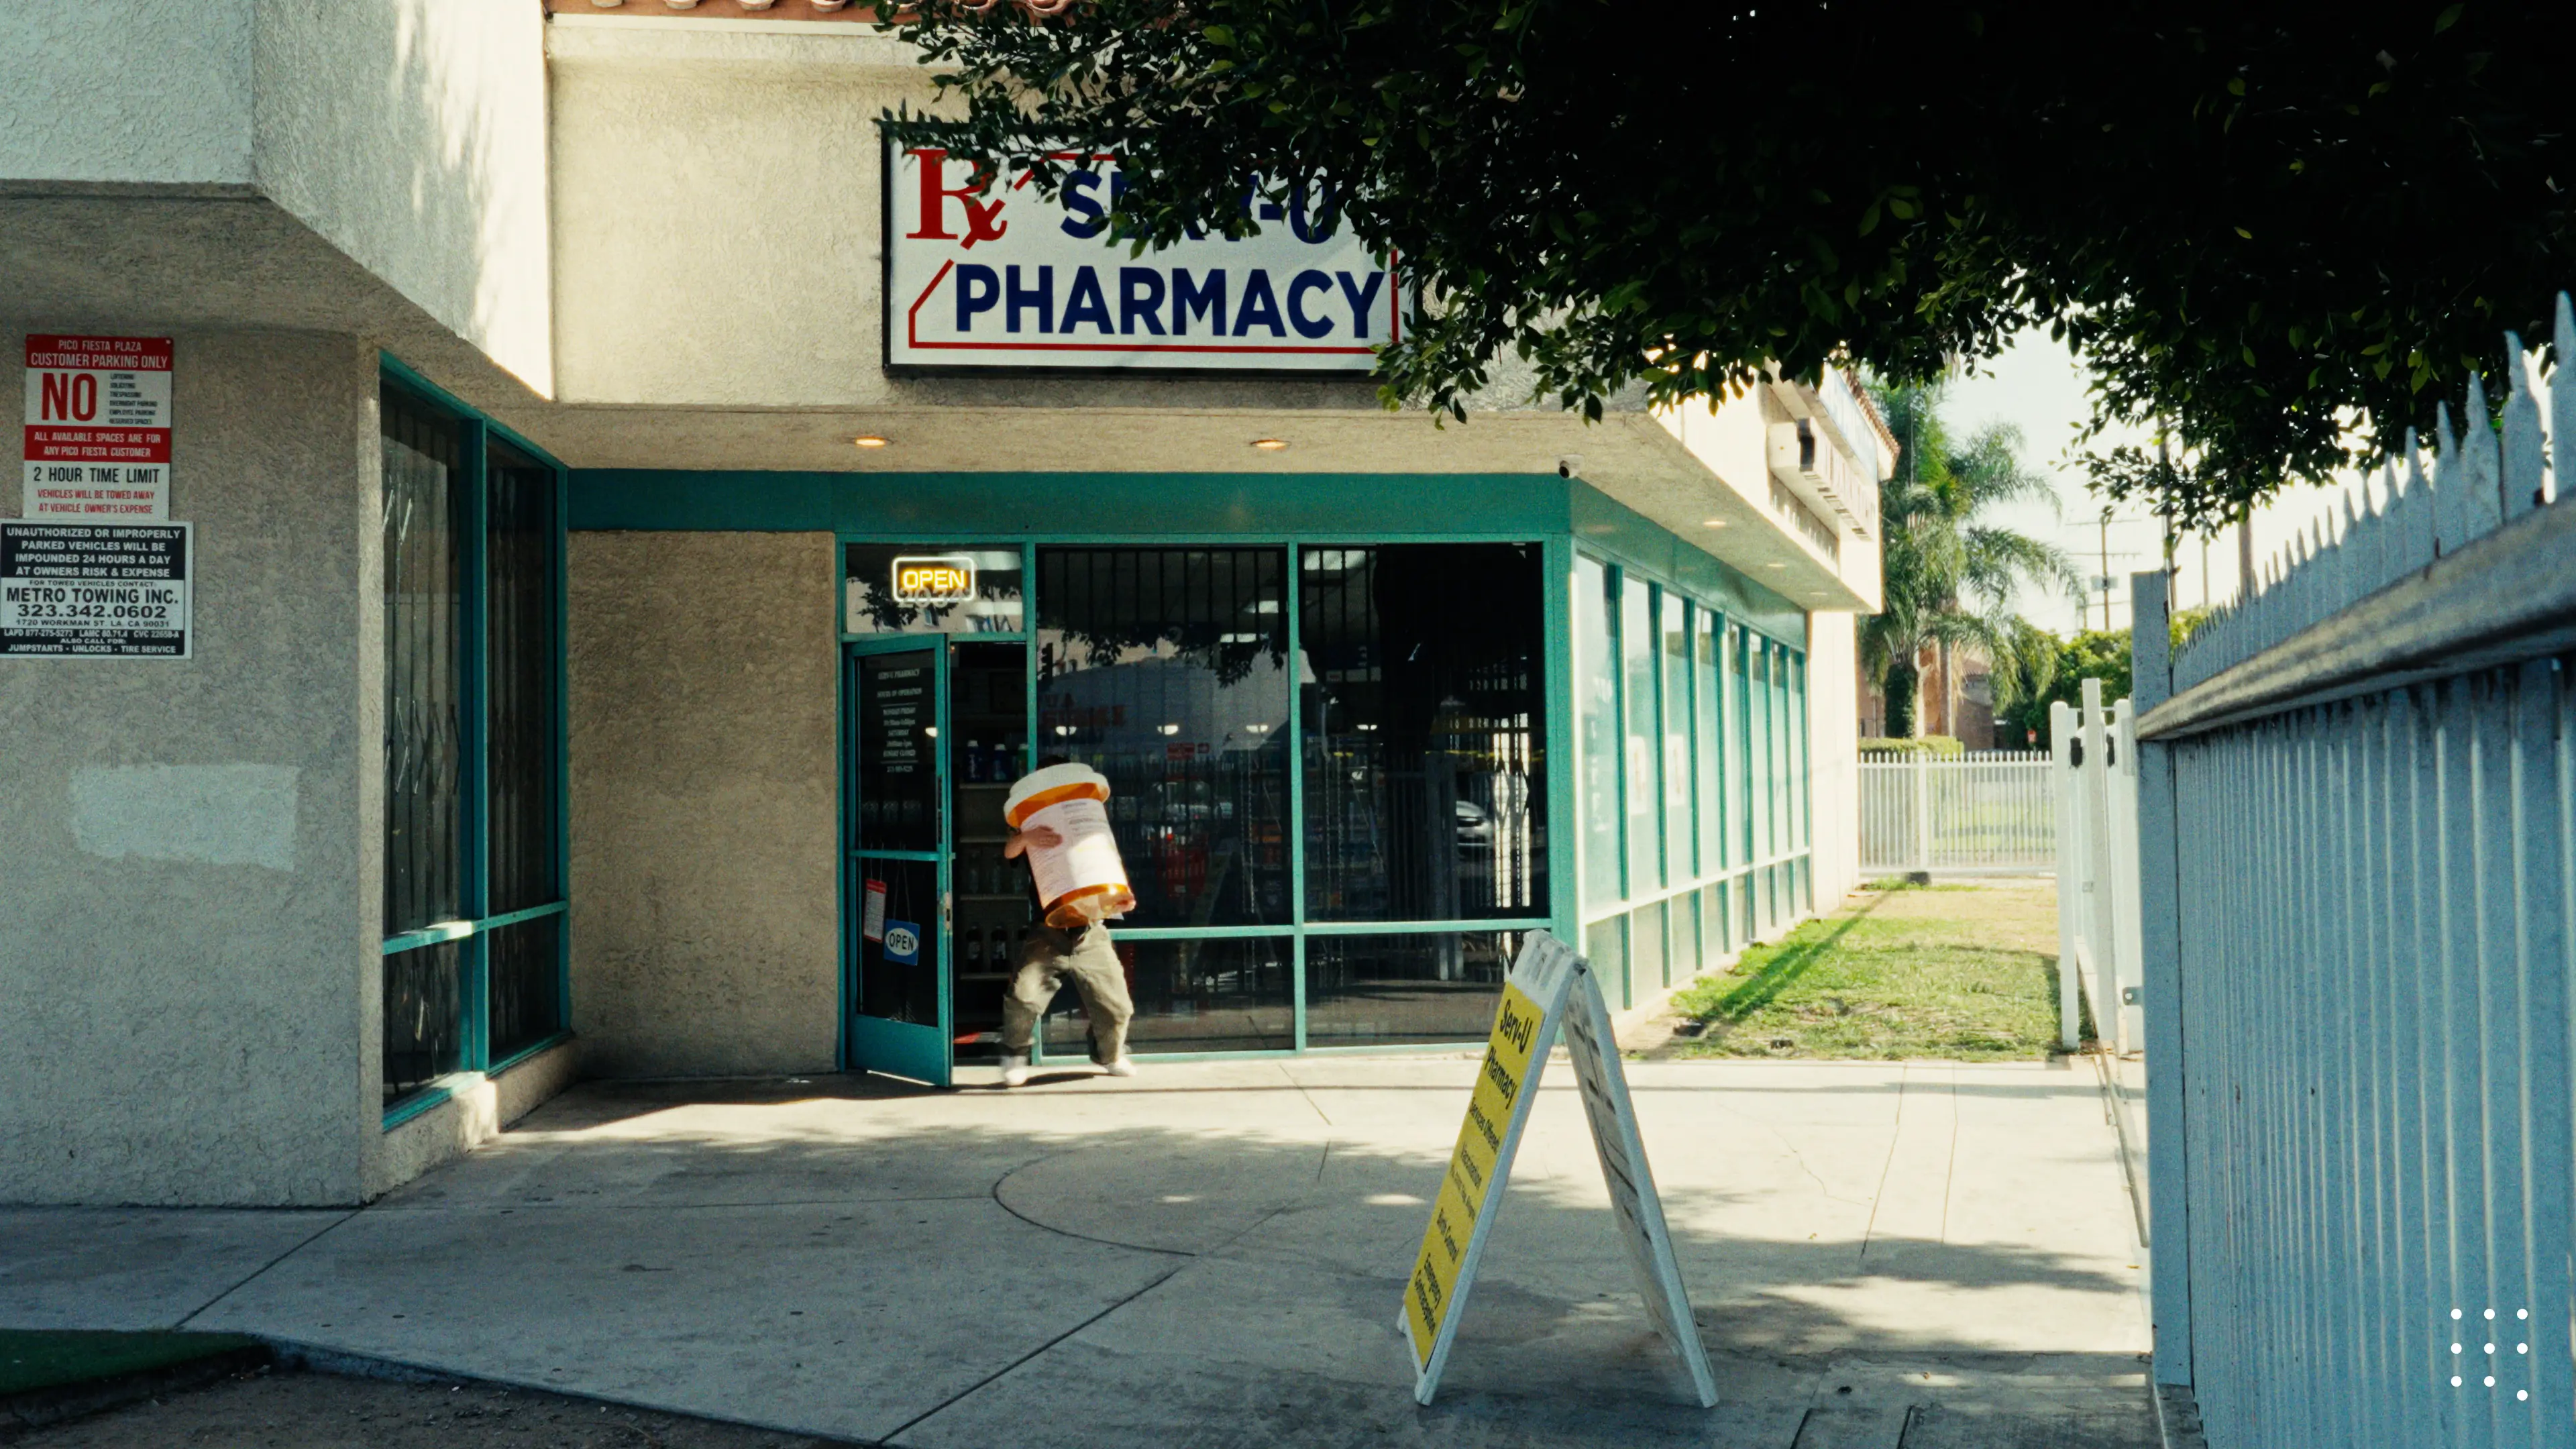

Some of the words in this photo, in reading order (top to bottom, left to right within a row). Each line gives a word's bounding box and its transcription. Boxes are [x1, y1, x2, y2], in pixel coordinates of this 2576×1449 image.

[956, 264, 1385, 339] PHARMACY
[58, 339, 78, 350] PICO
[83, 340, 110, 351] FIESTA
[115, 341, 142, 352] PLAZA
[31, 353, 89, 367] CUSTOMER
[93, 354, 138, 368] PARKING
[141, 356, 168, 368] ONLY
[42, 373, 97, 421] NO
[34, 432, 48, 441] ALL
[52, 432, 92, 442] AVAILABLE
[96, 433, 124, 443] SPACES
[128, 433, 142, 443] ARE
[146, 434, 161, 443] FOR
[44, 447, 58, 455] ANY
[61, 447, 78, 456] PICO
[83, 447, 107, 456] FIESTA
[111, 448, 151, 457] CUSTOMER
[34, 467, 41, 482] 2
[49, 467, 82, 482] HOUR
[89, 468, 119, 482] TIME
[127, 468, 160, 483] LIMIT
[38, 489, 73, 498] VEHICLES
[75, 490, 92, 499] WILL
[95, 490, 103, 499] BE
[106, 490, 131, 500] TOWED
[133, 491, 155, 500] AWAY
[38, 503, 48, 513] AT
[50, 503, 80, 513] VEHICLE
[85, 504, 118, 513] OWNER'S
[120, 504, 153, 514] EXPENSE
[7, 527, 91, 537] UNAUTHORIZED
[94, 529, 110, 537] OR
[113, 529, 180, 539] IMPROPERLY
[21, 540, 65, 549] PARKED
[68, 541, 120, 551] VEHICLES
[123, 542, 148, 551] WILL
[151, 543, 166, 551] BE
[15, 553, 80, 564] IMPOUNDED
[83, 554, 95, 564] 24
[99, 555, 136, 564] HOURS
[138, 555, 146, 564] A
[149, 555, 171, 564] DAY
[15, 566, 31, 576] AT
[34, 567, 80, 576] OWNERS
[83, 568, 108, 576] RISK
[111, 568, 119, 577] &
[121, 568, 170, 578] EXPENSE
[903, 570, 965, 588] OPEN
[7, 587, 66, 602] METRO
[72, 588, 139, 604] TOWING
[145, 589, 178, 604] INC.
[17, 604, 166, 619] 323.342.0602
[8, 644, 63, 652] JUMPSTARTS
[72, 645, 111, 653] UNLOCKS
[121, 645, 140, 653] TIRE
[141, 645, 176, 653] SERVICE
[889, 932, 914, 951] OPEN
[1499, 998, 1534, 1054] Serv-U
[1485, 1045, 1517, 1110] Pharmacy
